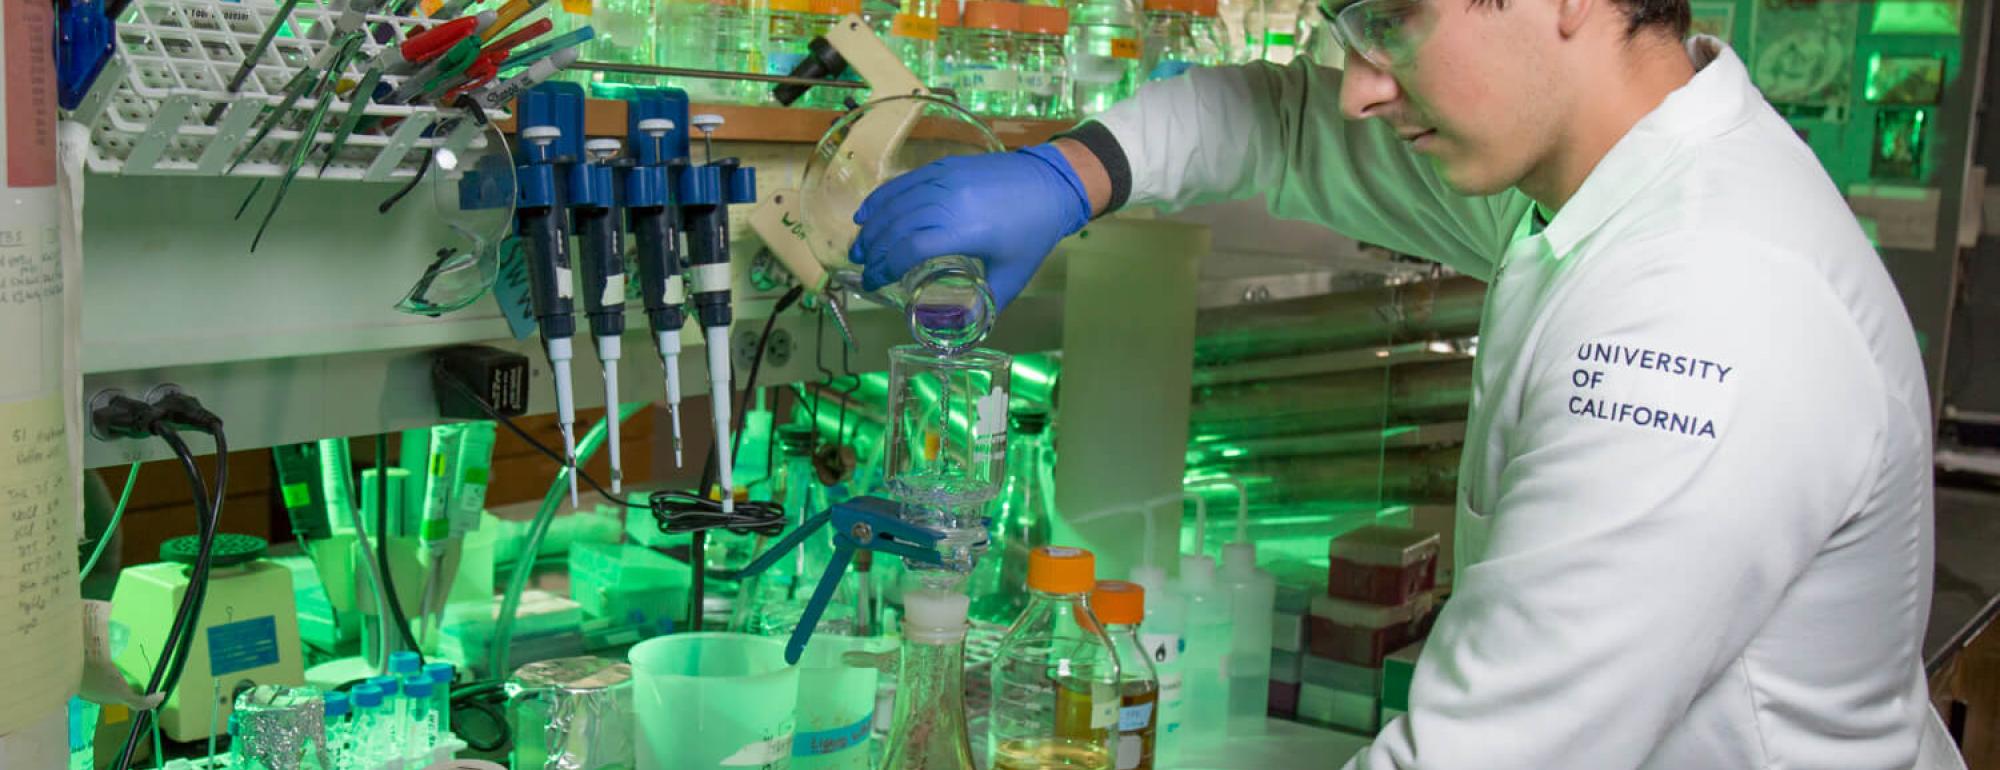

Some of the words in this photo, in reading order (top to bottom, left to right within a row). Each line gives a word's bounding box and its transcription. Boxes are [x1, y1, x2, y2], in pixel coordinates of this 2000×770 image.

[1572, 369, 1605, 389] OF
[1577, 343, 1733, 384] UNIVERSITY
[1568, 396, 1716, 439] CALIFORNIA
